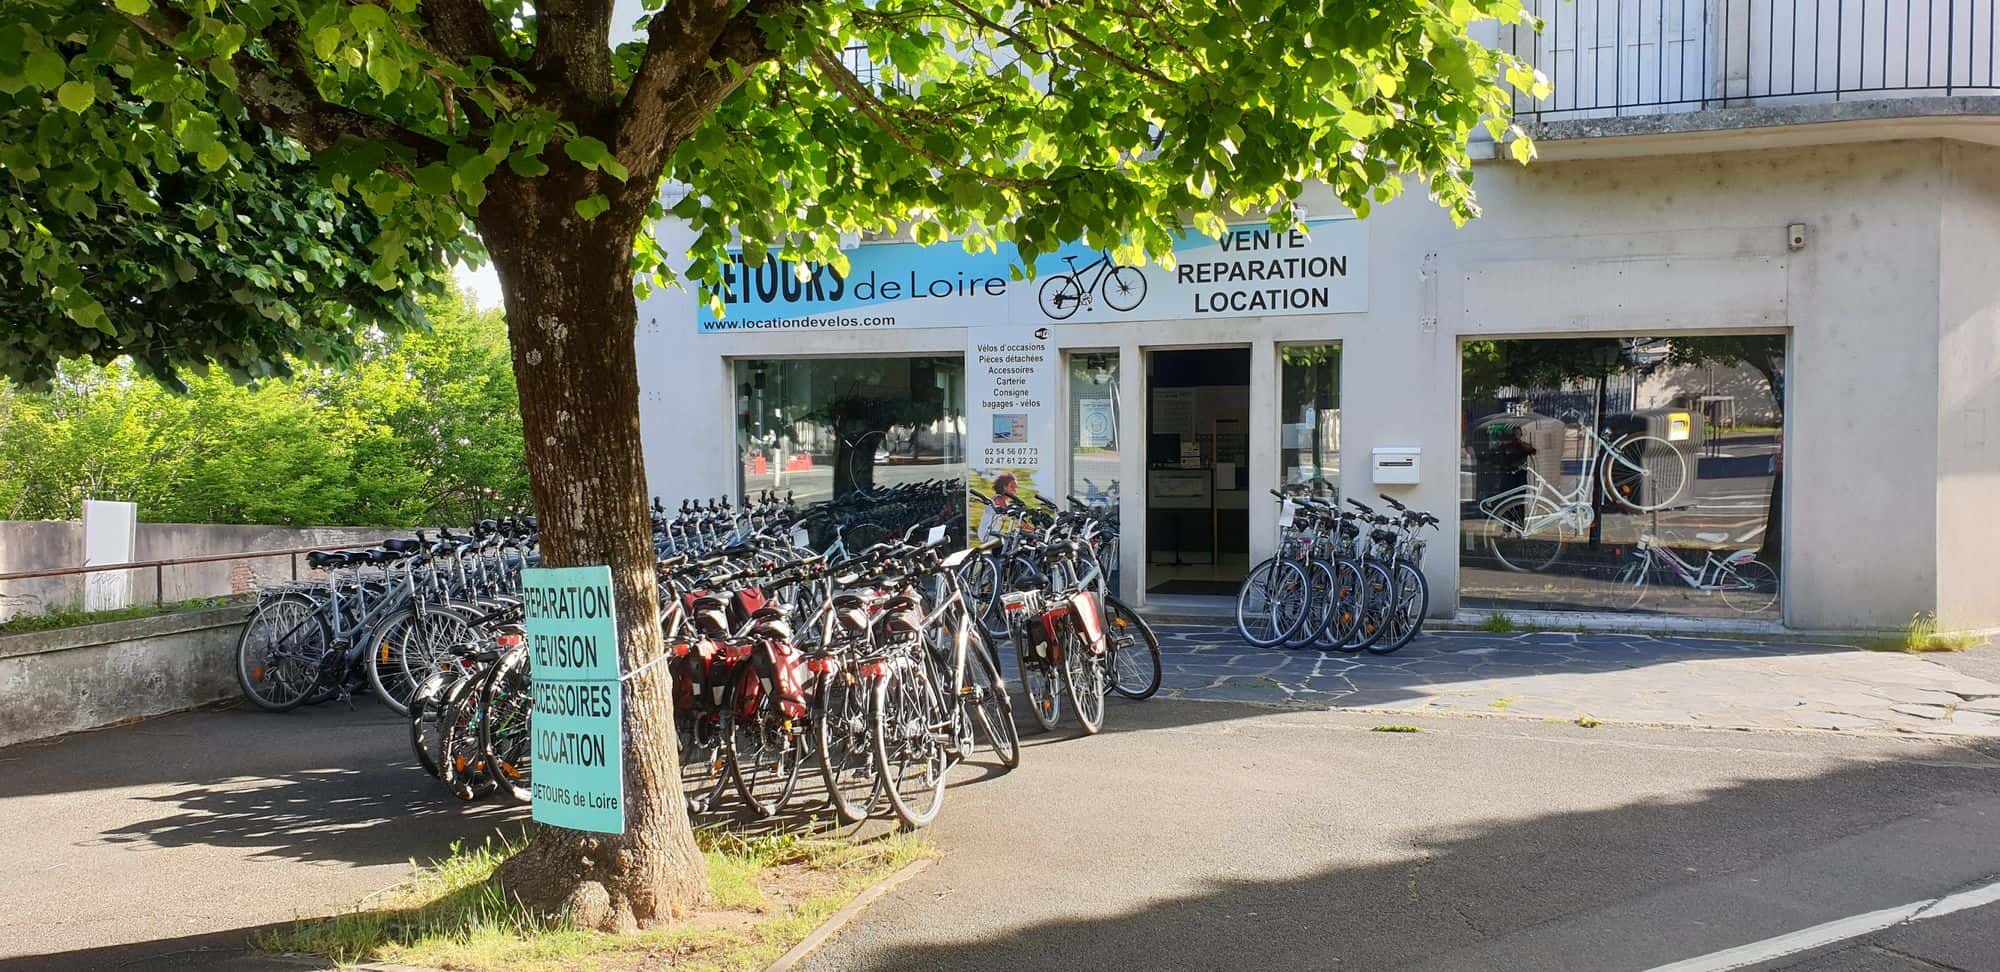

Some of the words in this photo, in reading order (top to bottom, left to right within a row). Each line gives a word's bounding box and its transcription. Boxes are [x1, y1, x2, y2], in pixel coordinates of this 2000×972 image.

[1178, 255, 1347, 284] REPARATION
[854, 271, 900, 300] de
[911, 270, 1006, 298] Loire
[1194, 287, 1329, 313] LOCATION
[704, 315, 895, 330] www.locationdevelos.com
[1000, 343, 1045, 351] d'occasions
[988, 366, 1034, 374] Accessoires
[996, 377, 1026, 385] Carterie
[982, 400, 1014, 409] bagages
[993, 388, 1029, 397] Consigne
[524, 586, 610, 619] REPARATION
[535, 635, 597, 668] REVISION
[533, 683, 612, 718] ACCESSOIRES
[537, 728, 605, 767] LOCATION
[533, 782, 570, 805] DETOURS
[573, 791, 585, 807] de
[588, 794, 618, 810] Loire
